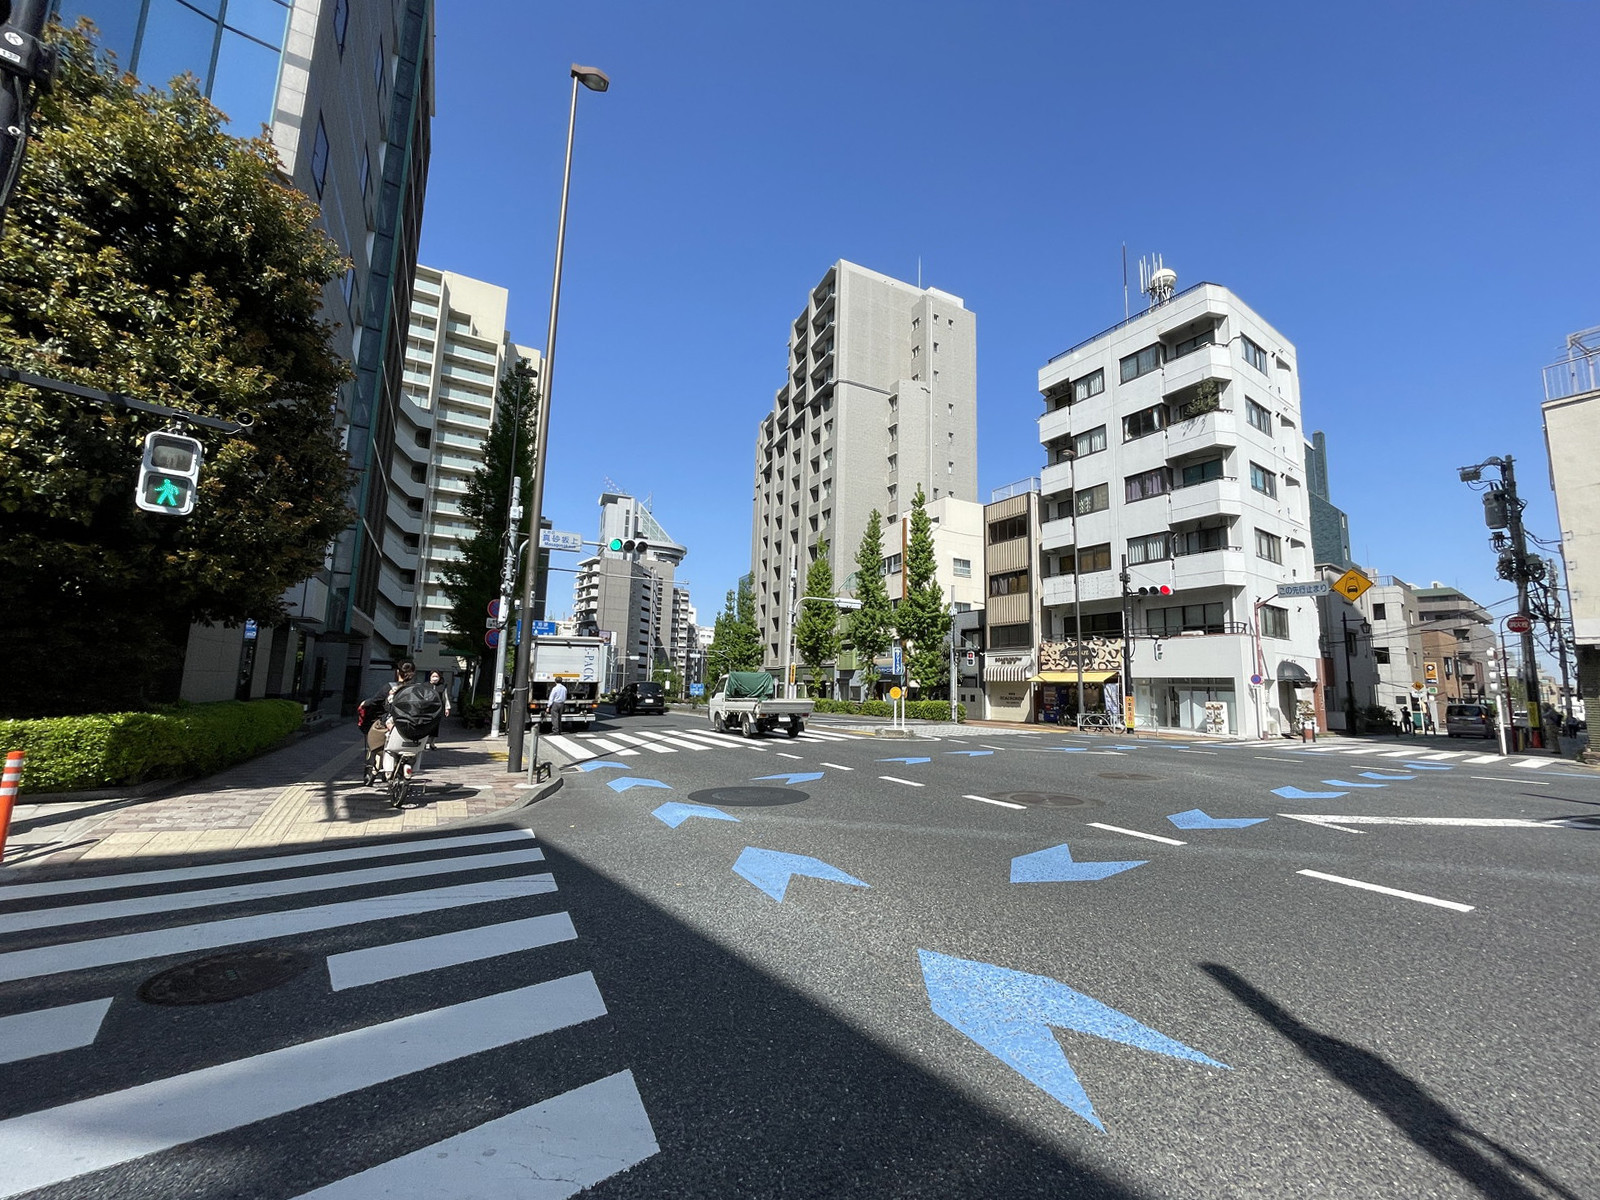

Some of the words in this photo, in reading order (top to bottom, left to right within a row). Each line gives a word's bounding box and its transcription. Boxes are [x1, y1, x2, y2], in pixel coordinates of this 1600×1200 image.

[543, 534, 579, 545] 真砂坂上
[1279, 583, 1327, 595] この先行止まり
